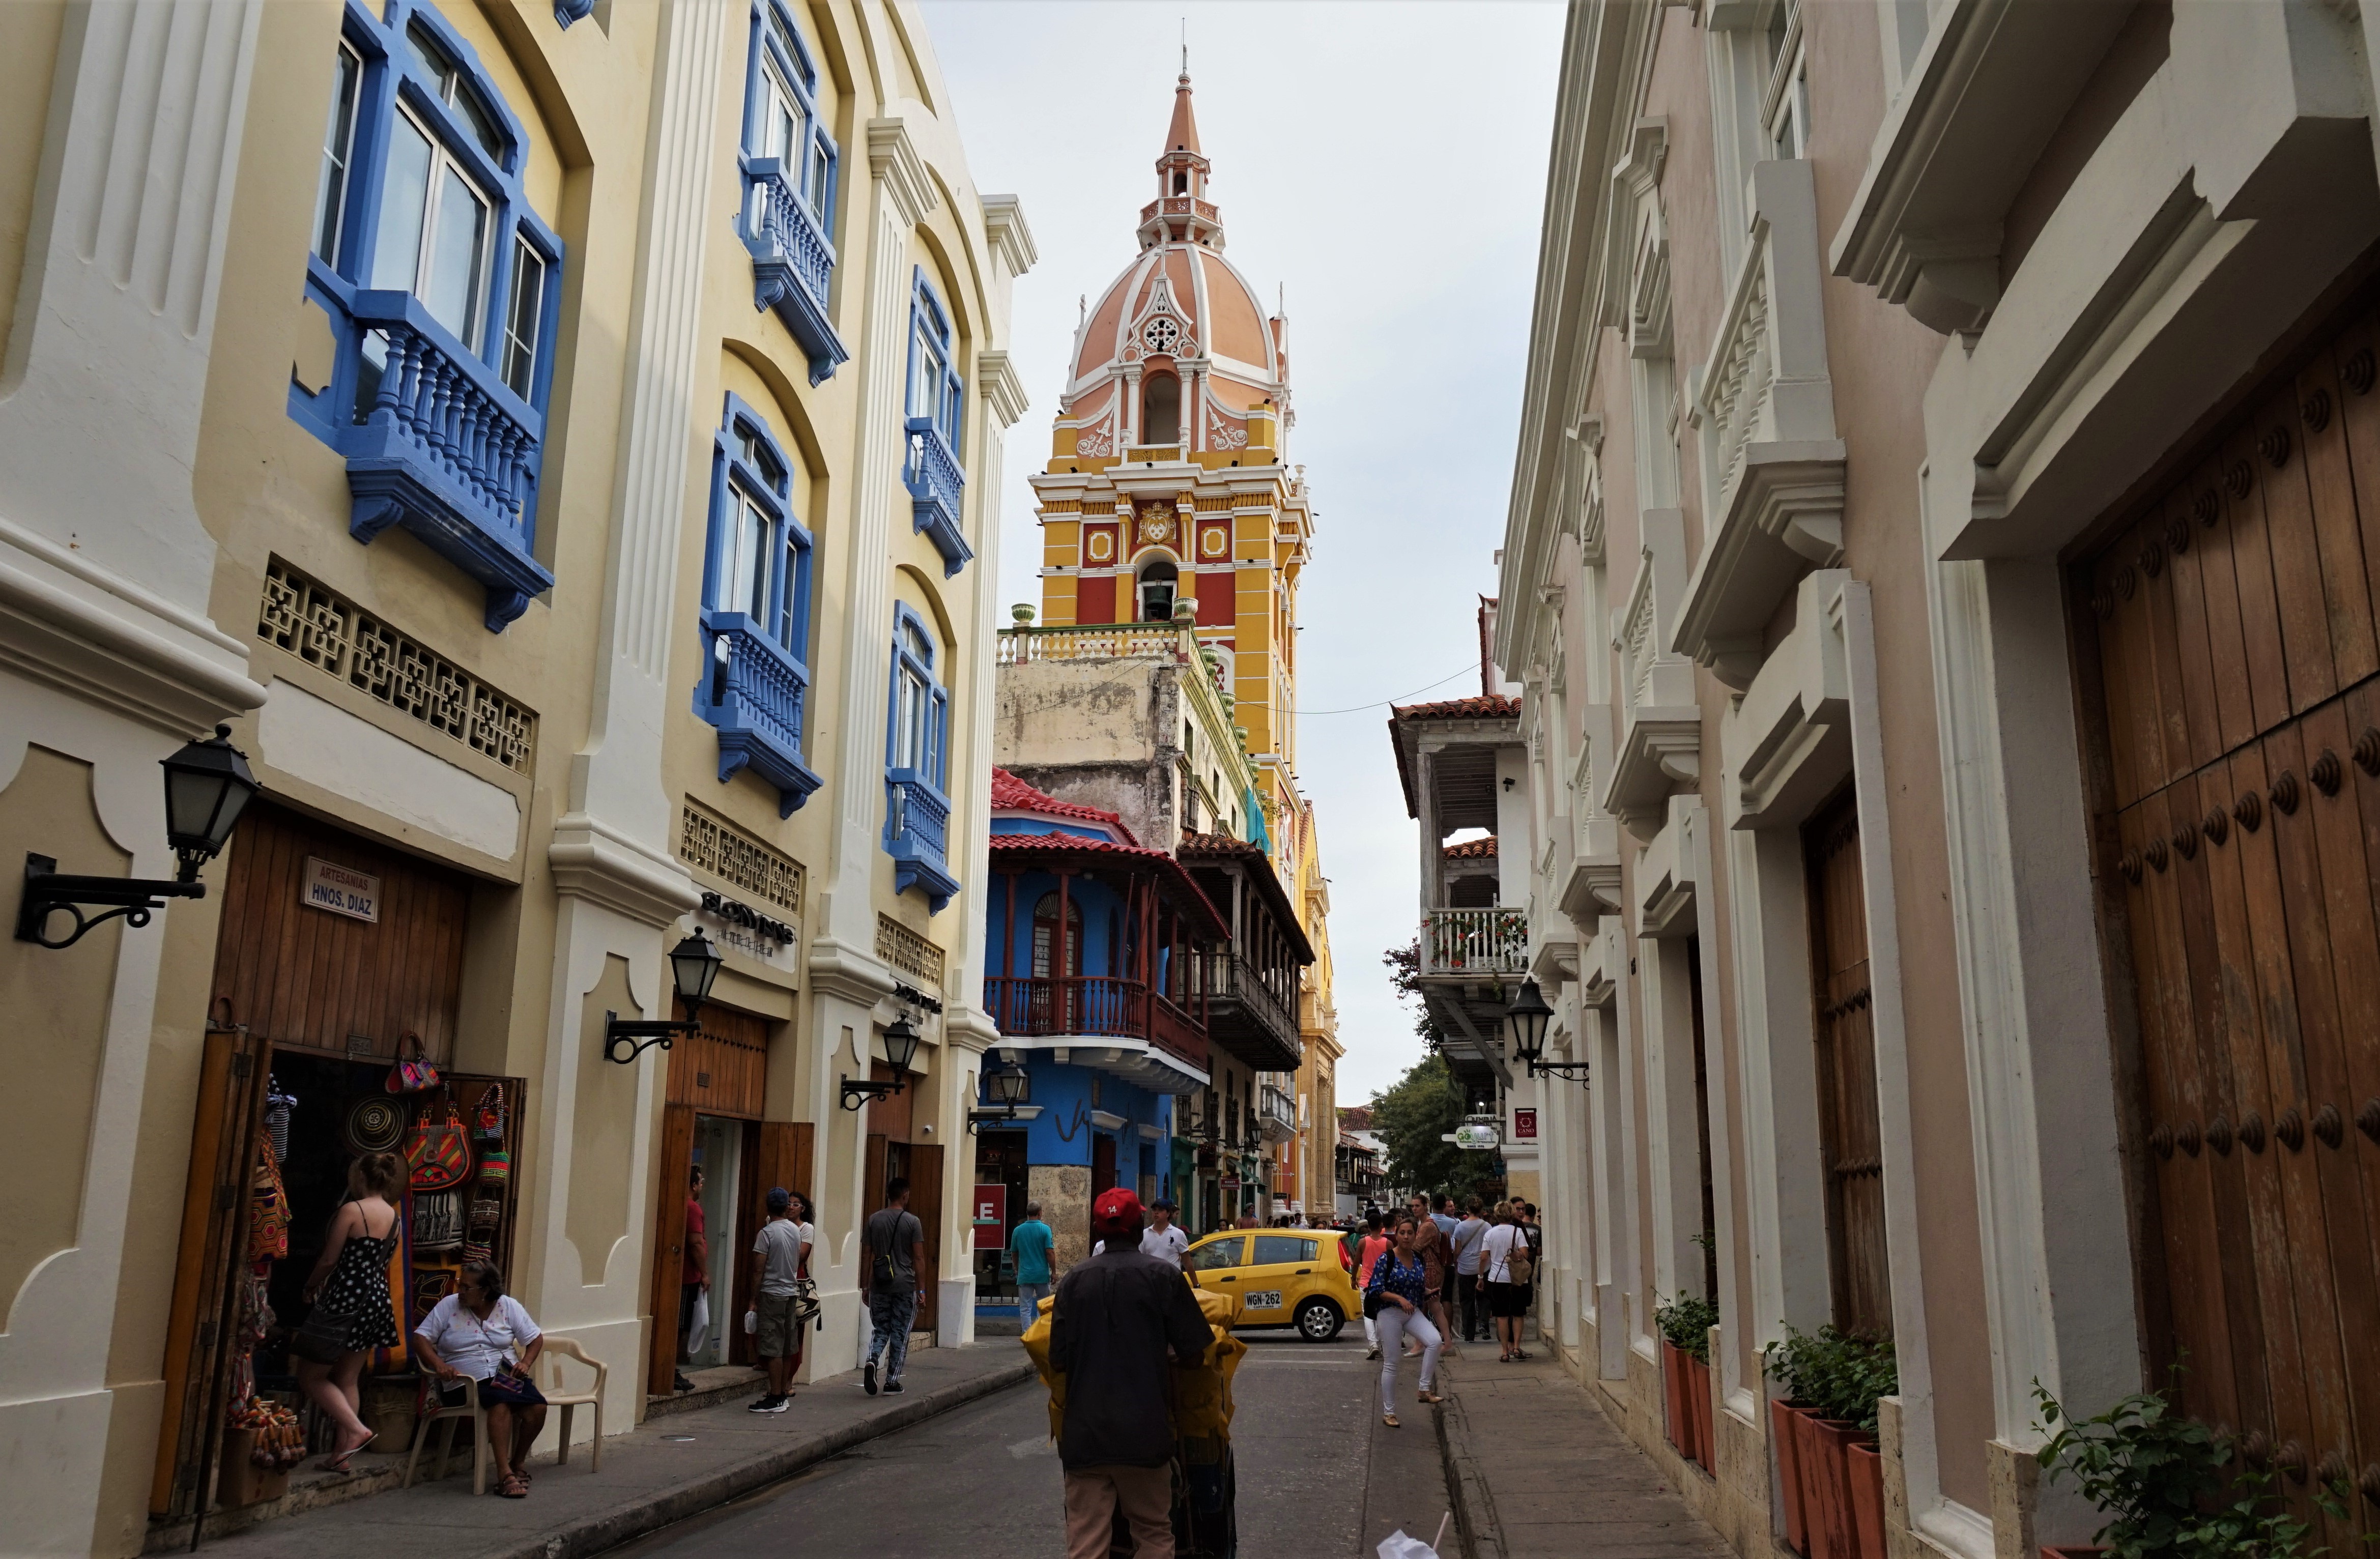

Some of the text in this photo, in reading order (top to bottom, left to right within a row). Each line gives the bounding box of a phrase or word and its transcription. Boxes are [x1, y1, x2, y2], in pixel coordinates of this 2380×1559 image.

[320, 866, 368, 891] ARTESANIAS
[312, 883, 372, 915] HNOS. DIAZ
[1107, 1205, 1117, 1215] 14
[1246, 1293, 1280, 1306] WGN 262
